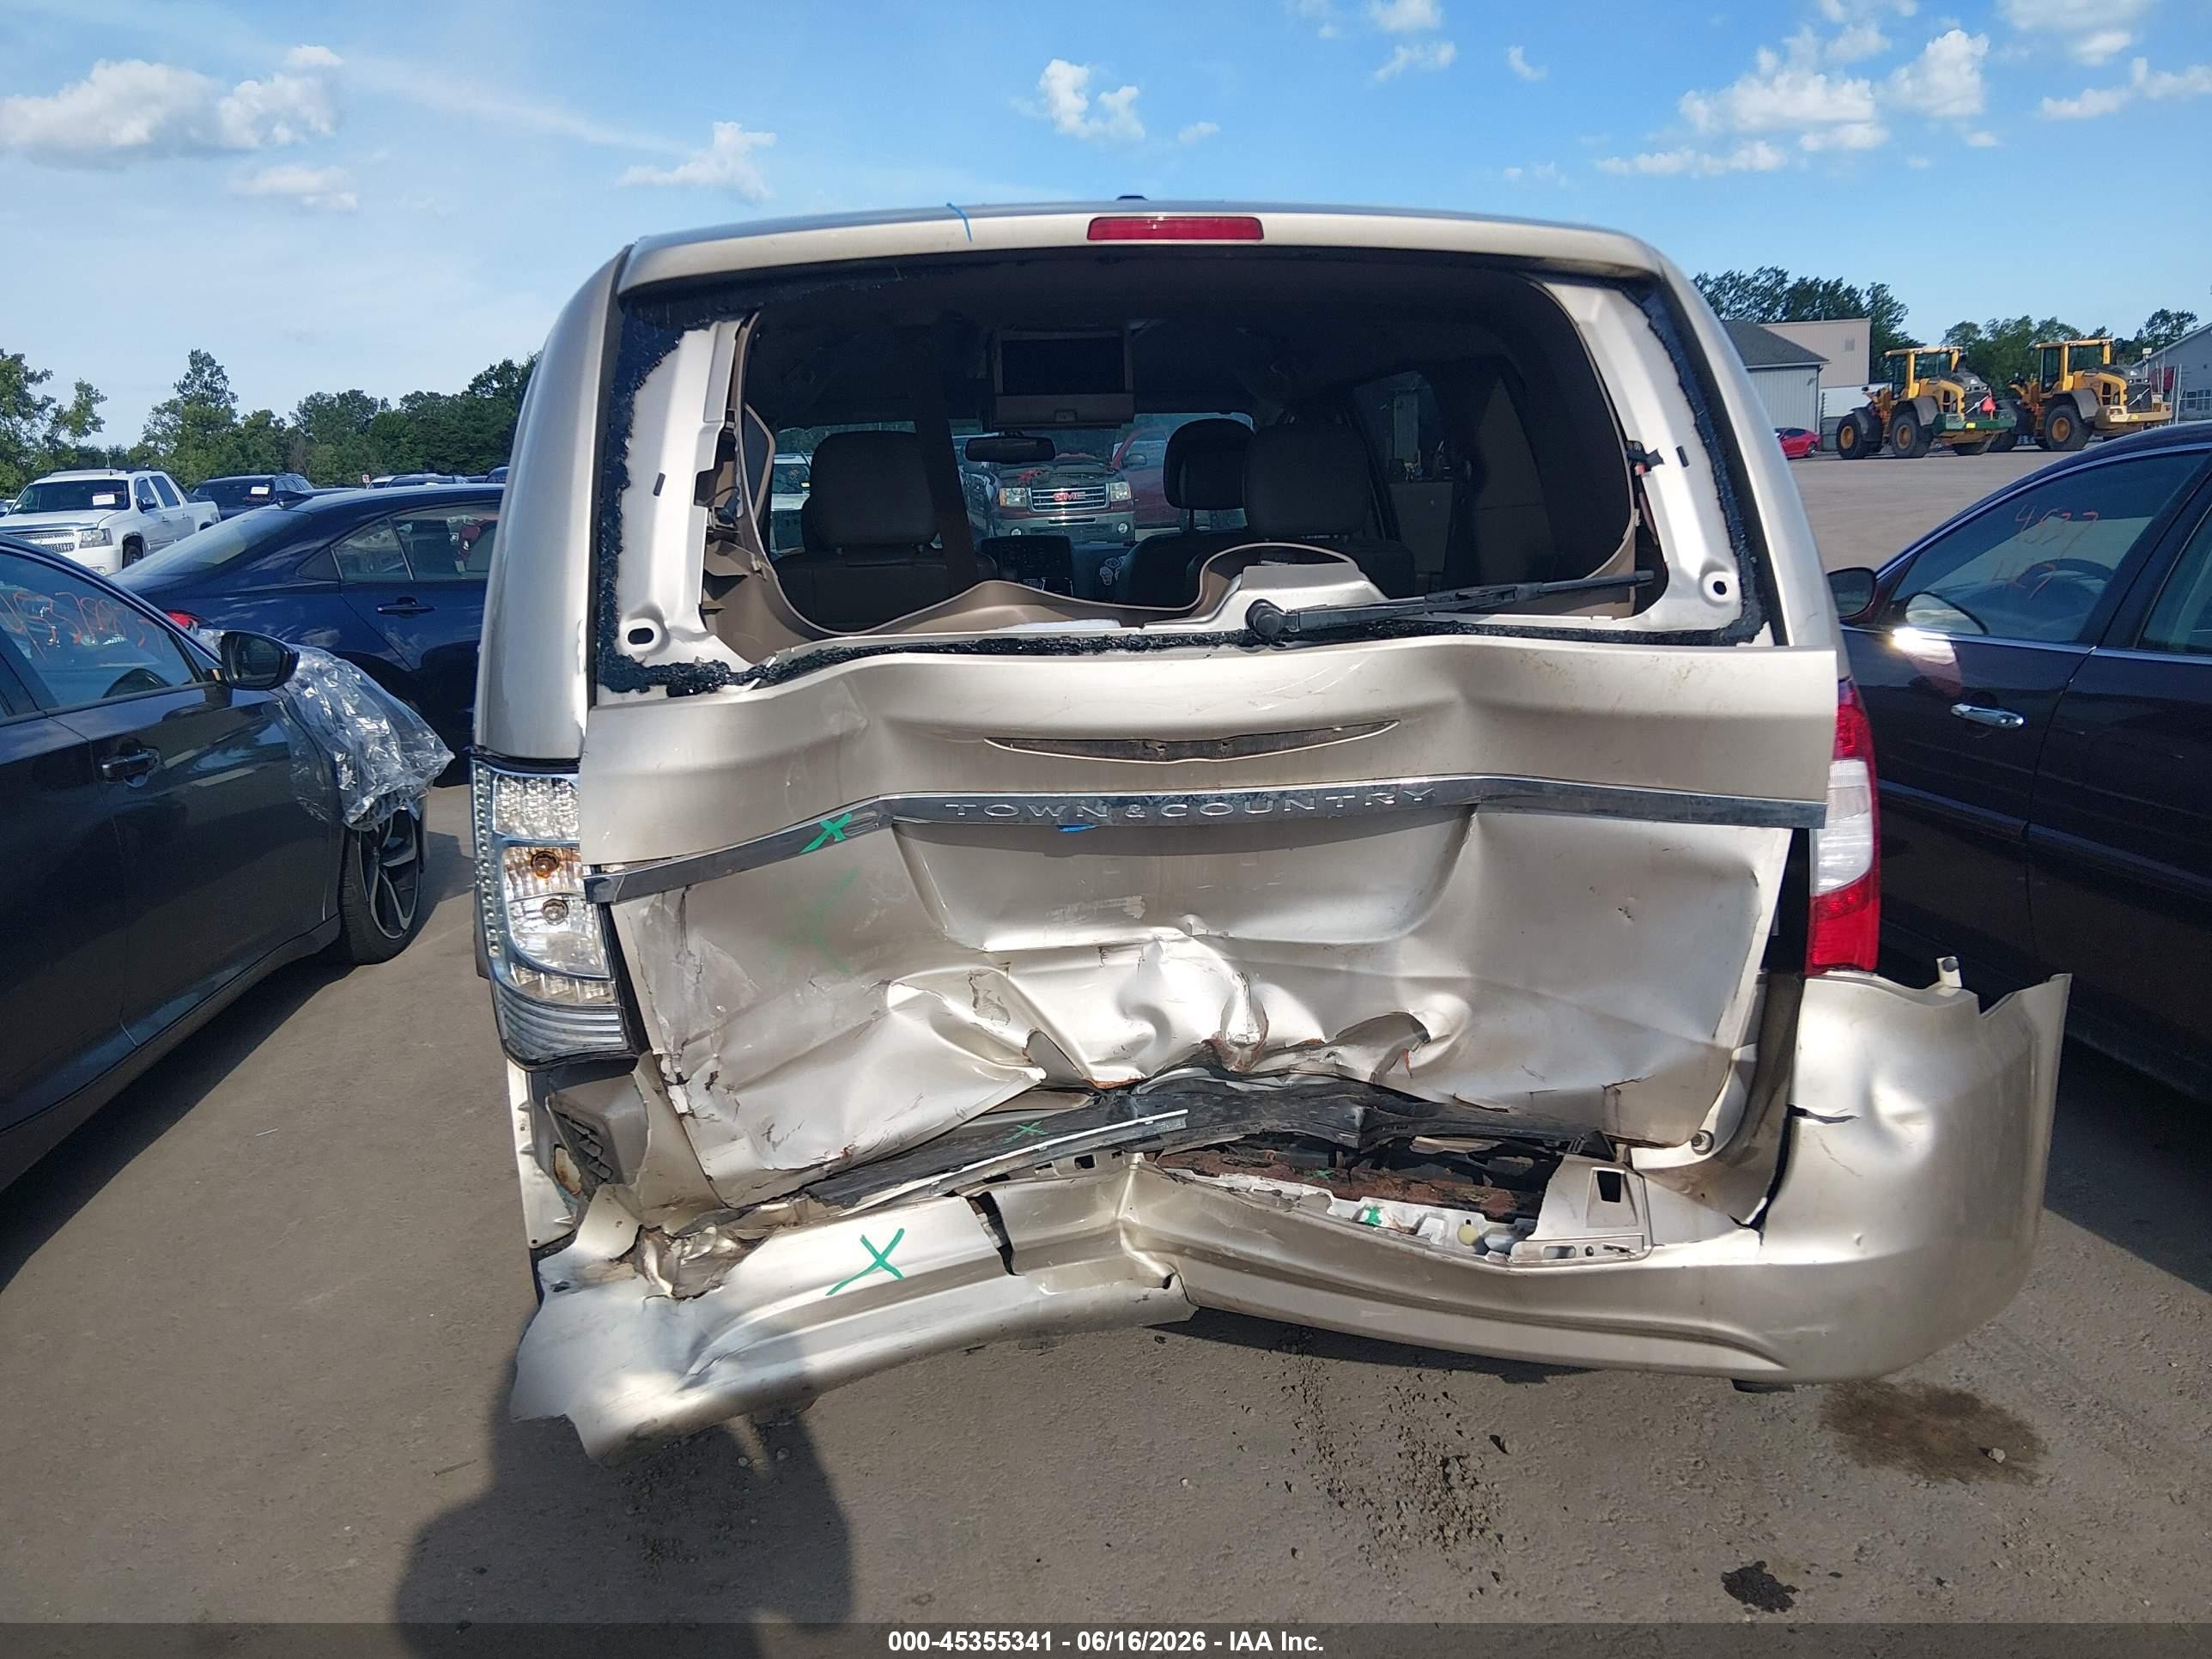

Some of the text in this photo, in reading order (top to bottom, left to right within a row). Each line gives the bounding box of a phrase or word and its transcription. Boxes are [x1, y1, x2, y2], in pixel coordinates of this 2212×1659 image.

[945, 787, 1436, 818] TOWN & COUNTRY
